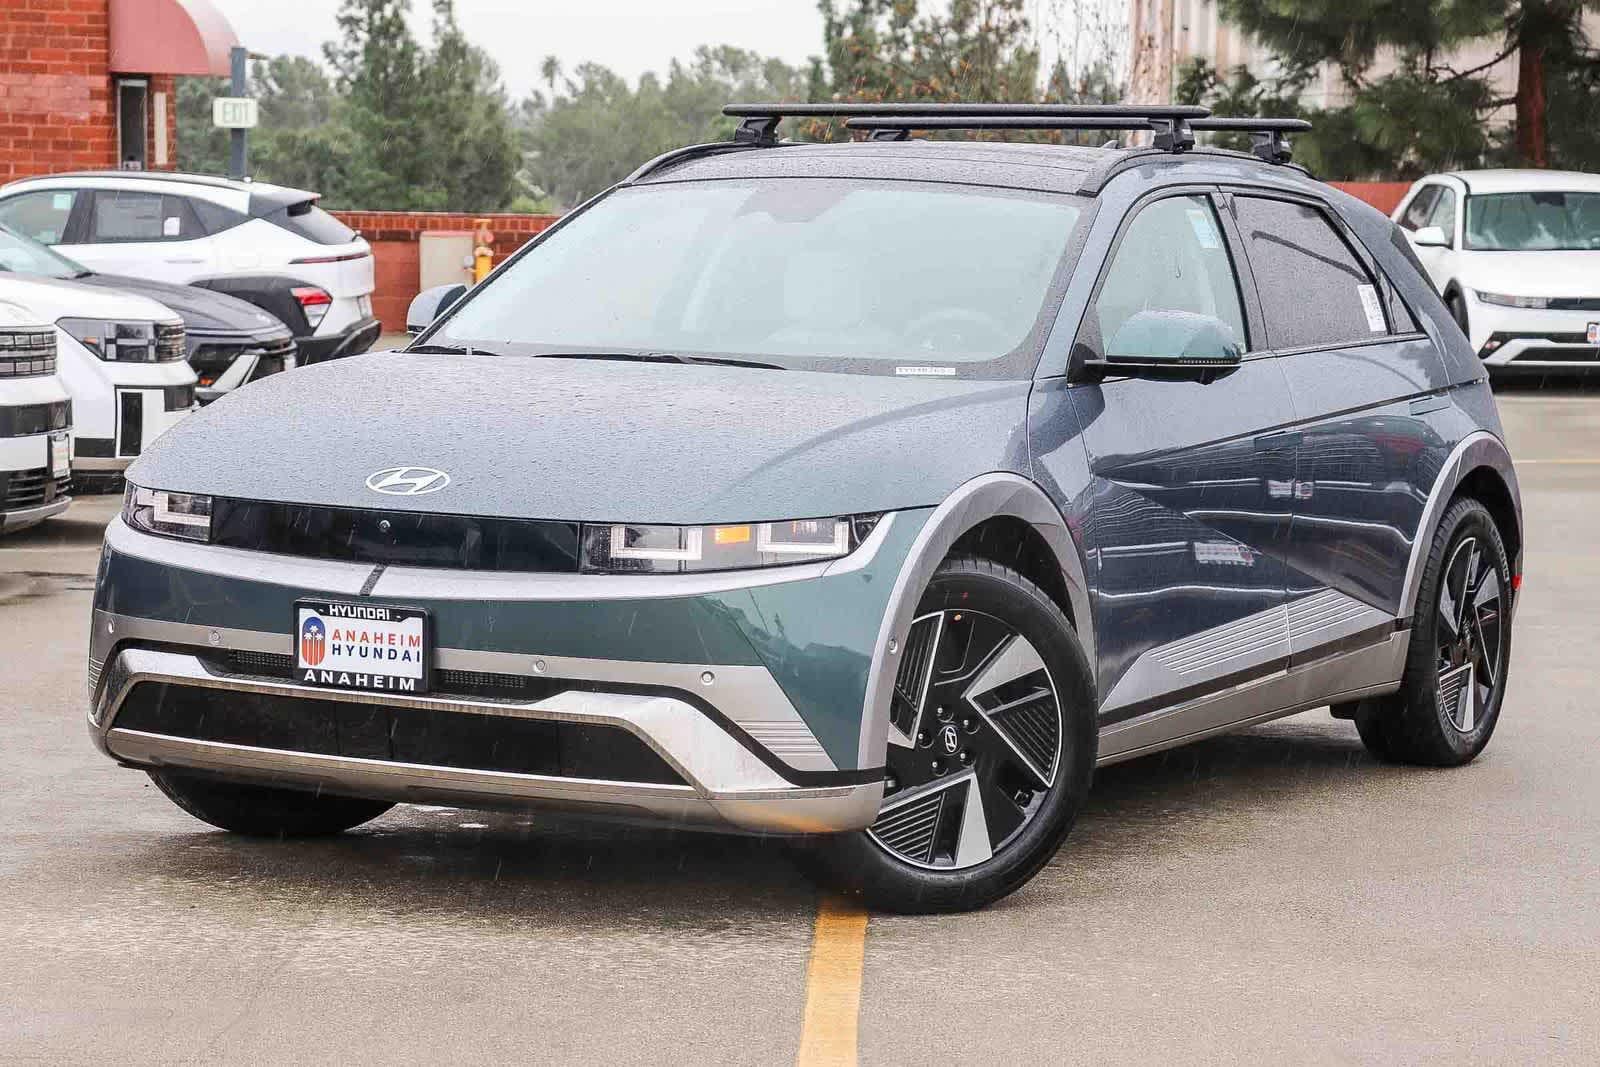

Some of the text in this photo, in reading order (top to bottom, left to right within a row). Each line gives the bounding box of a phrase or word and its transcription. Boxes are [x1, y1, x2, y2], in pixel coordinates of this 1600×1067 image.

[329, 604, 390, 620] HYUNDAI
[332, 628, 421, 647] ANAHEIM
[332, 643, 420, 663] HYUNDAI
[303, 669, 415, 691] ANAHEIM
